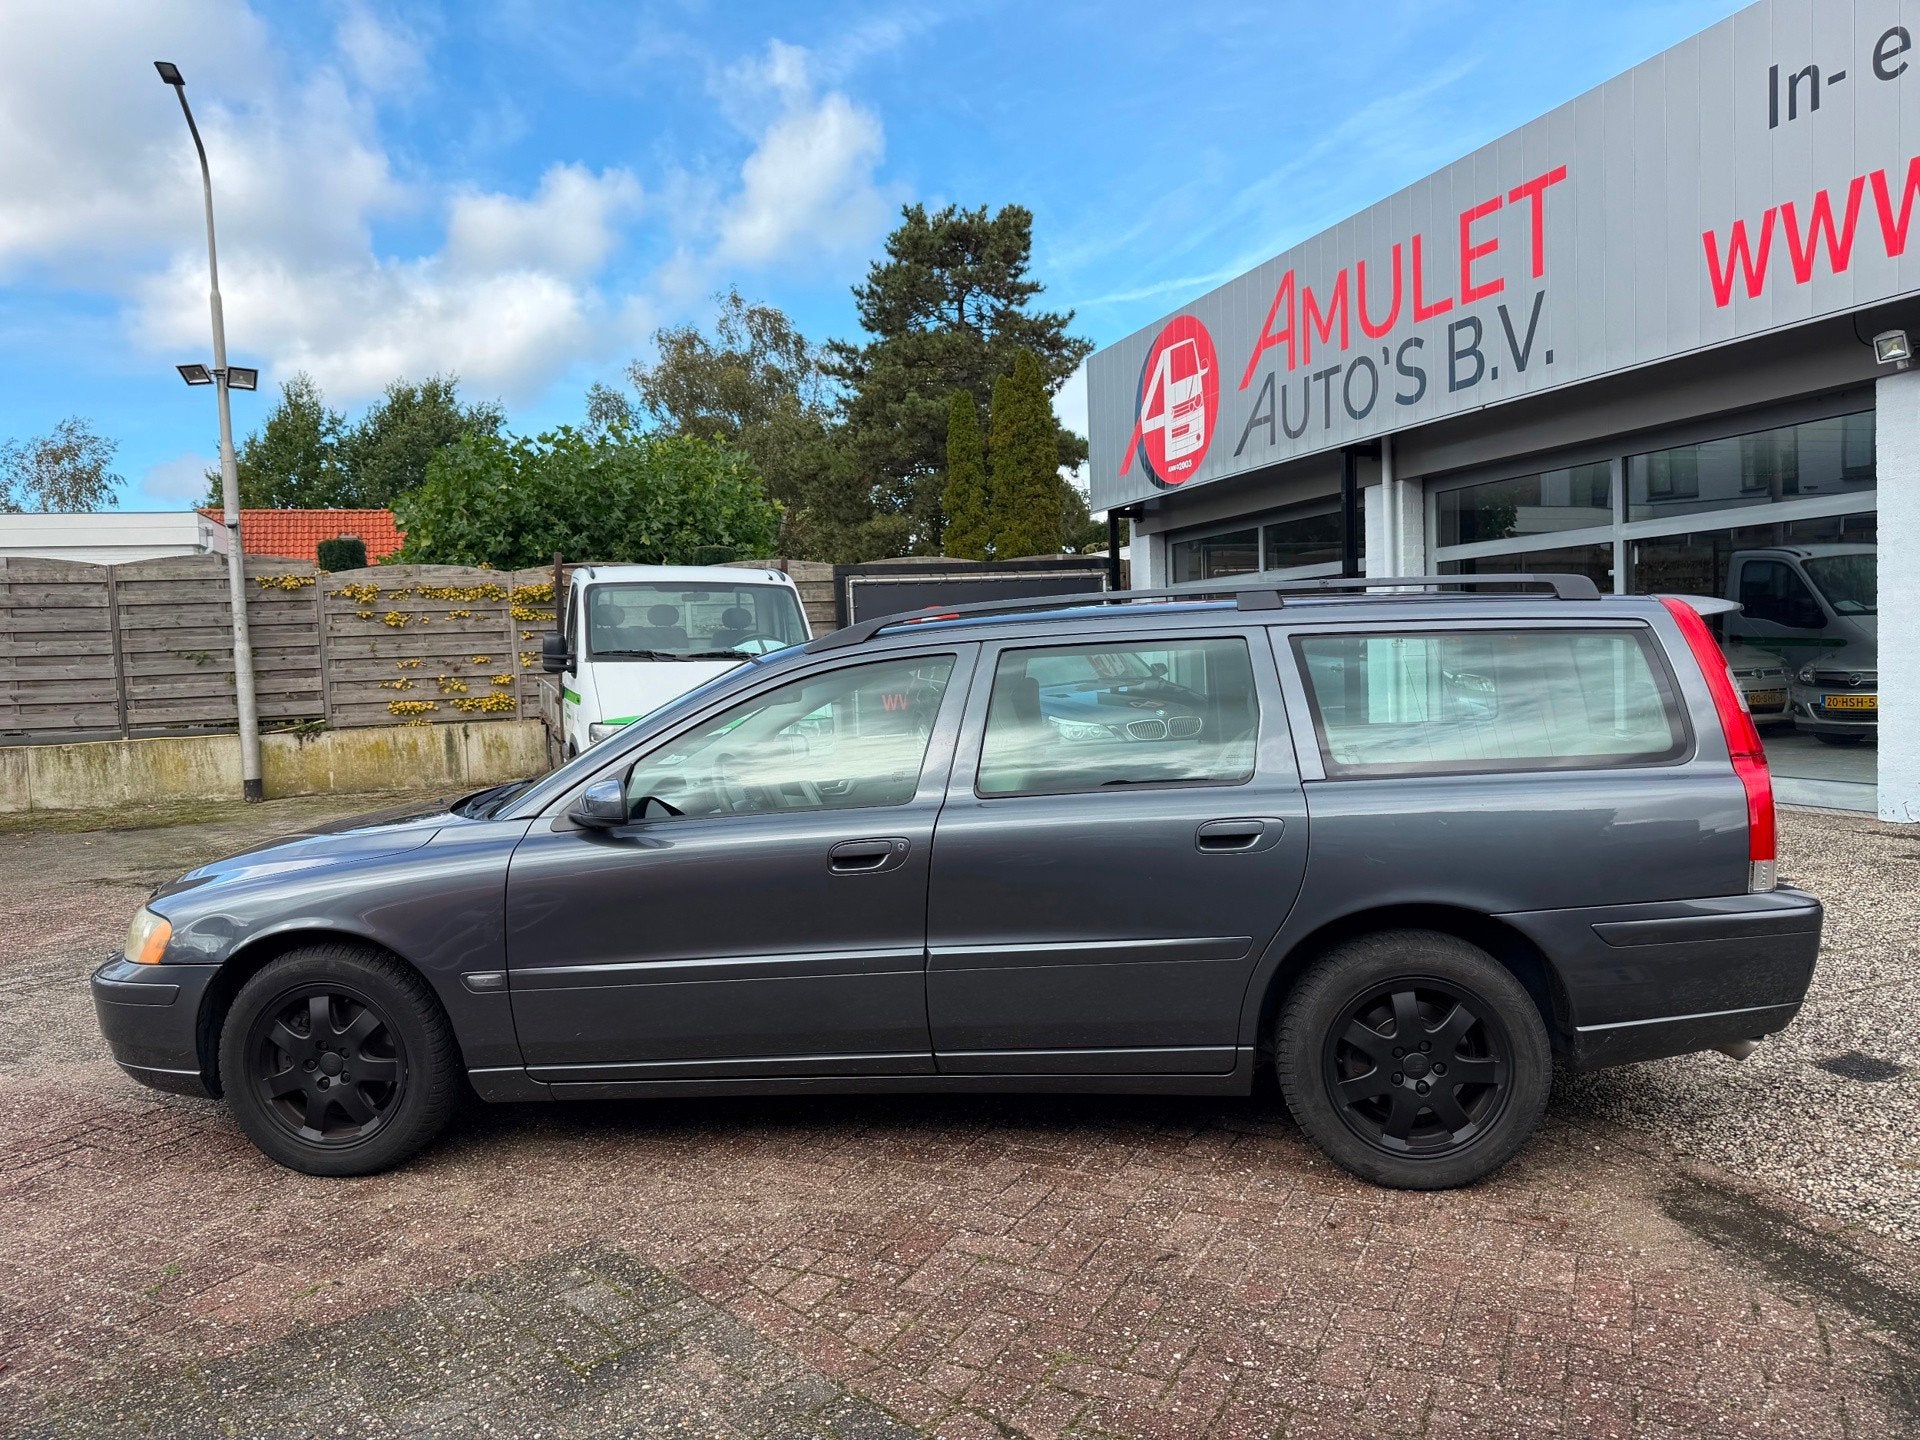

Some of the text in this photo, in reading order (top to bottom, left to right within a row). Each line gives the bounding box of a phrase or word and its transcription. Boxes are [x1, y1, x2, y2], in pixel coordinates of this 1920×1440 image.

[1768, 64, 1847, 130] In-
[1238, 164, 1567, 391] AMULET
[1233, 289, 1554, 457] AUTO'S B.V.
[1826, 697, 1876, 708] 20-HSH-5
